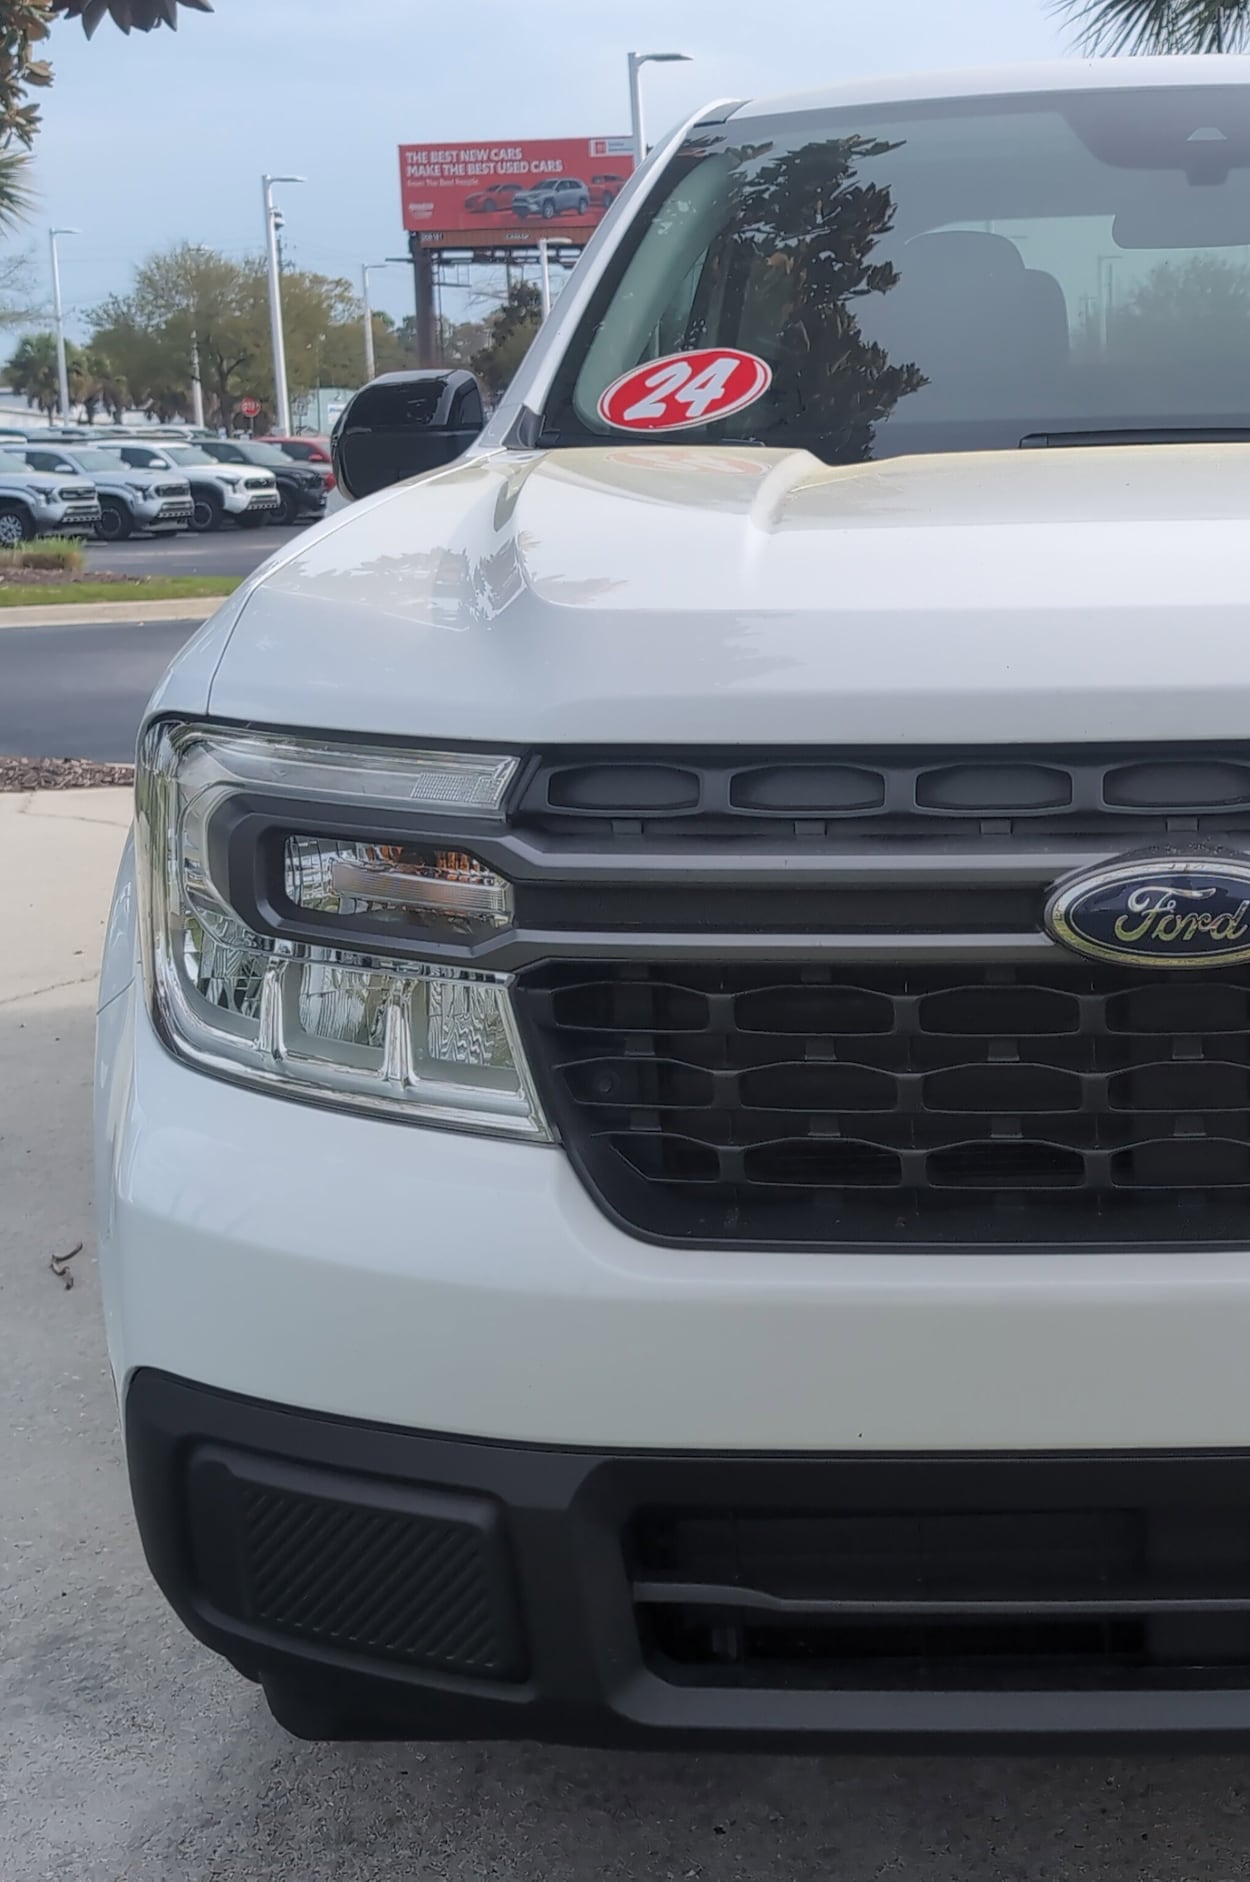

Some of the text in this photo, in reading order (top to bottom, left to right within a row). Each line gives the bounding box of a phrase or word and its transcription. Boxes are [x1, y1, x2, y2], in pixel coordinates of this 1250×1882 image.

[406, 147, 523, 164] THE BEST NEW CARS
[406, 160, 563, 177] MAKE THE BEST USED CARS
[623, 357, 741, 421] 24
[1114, 886, 1250, 942] Ford
